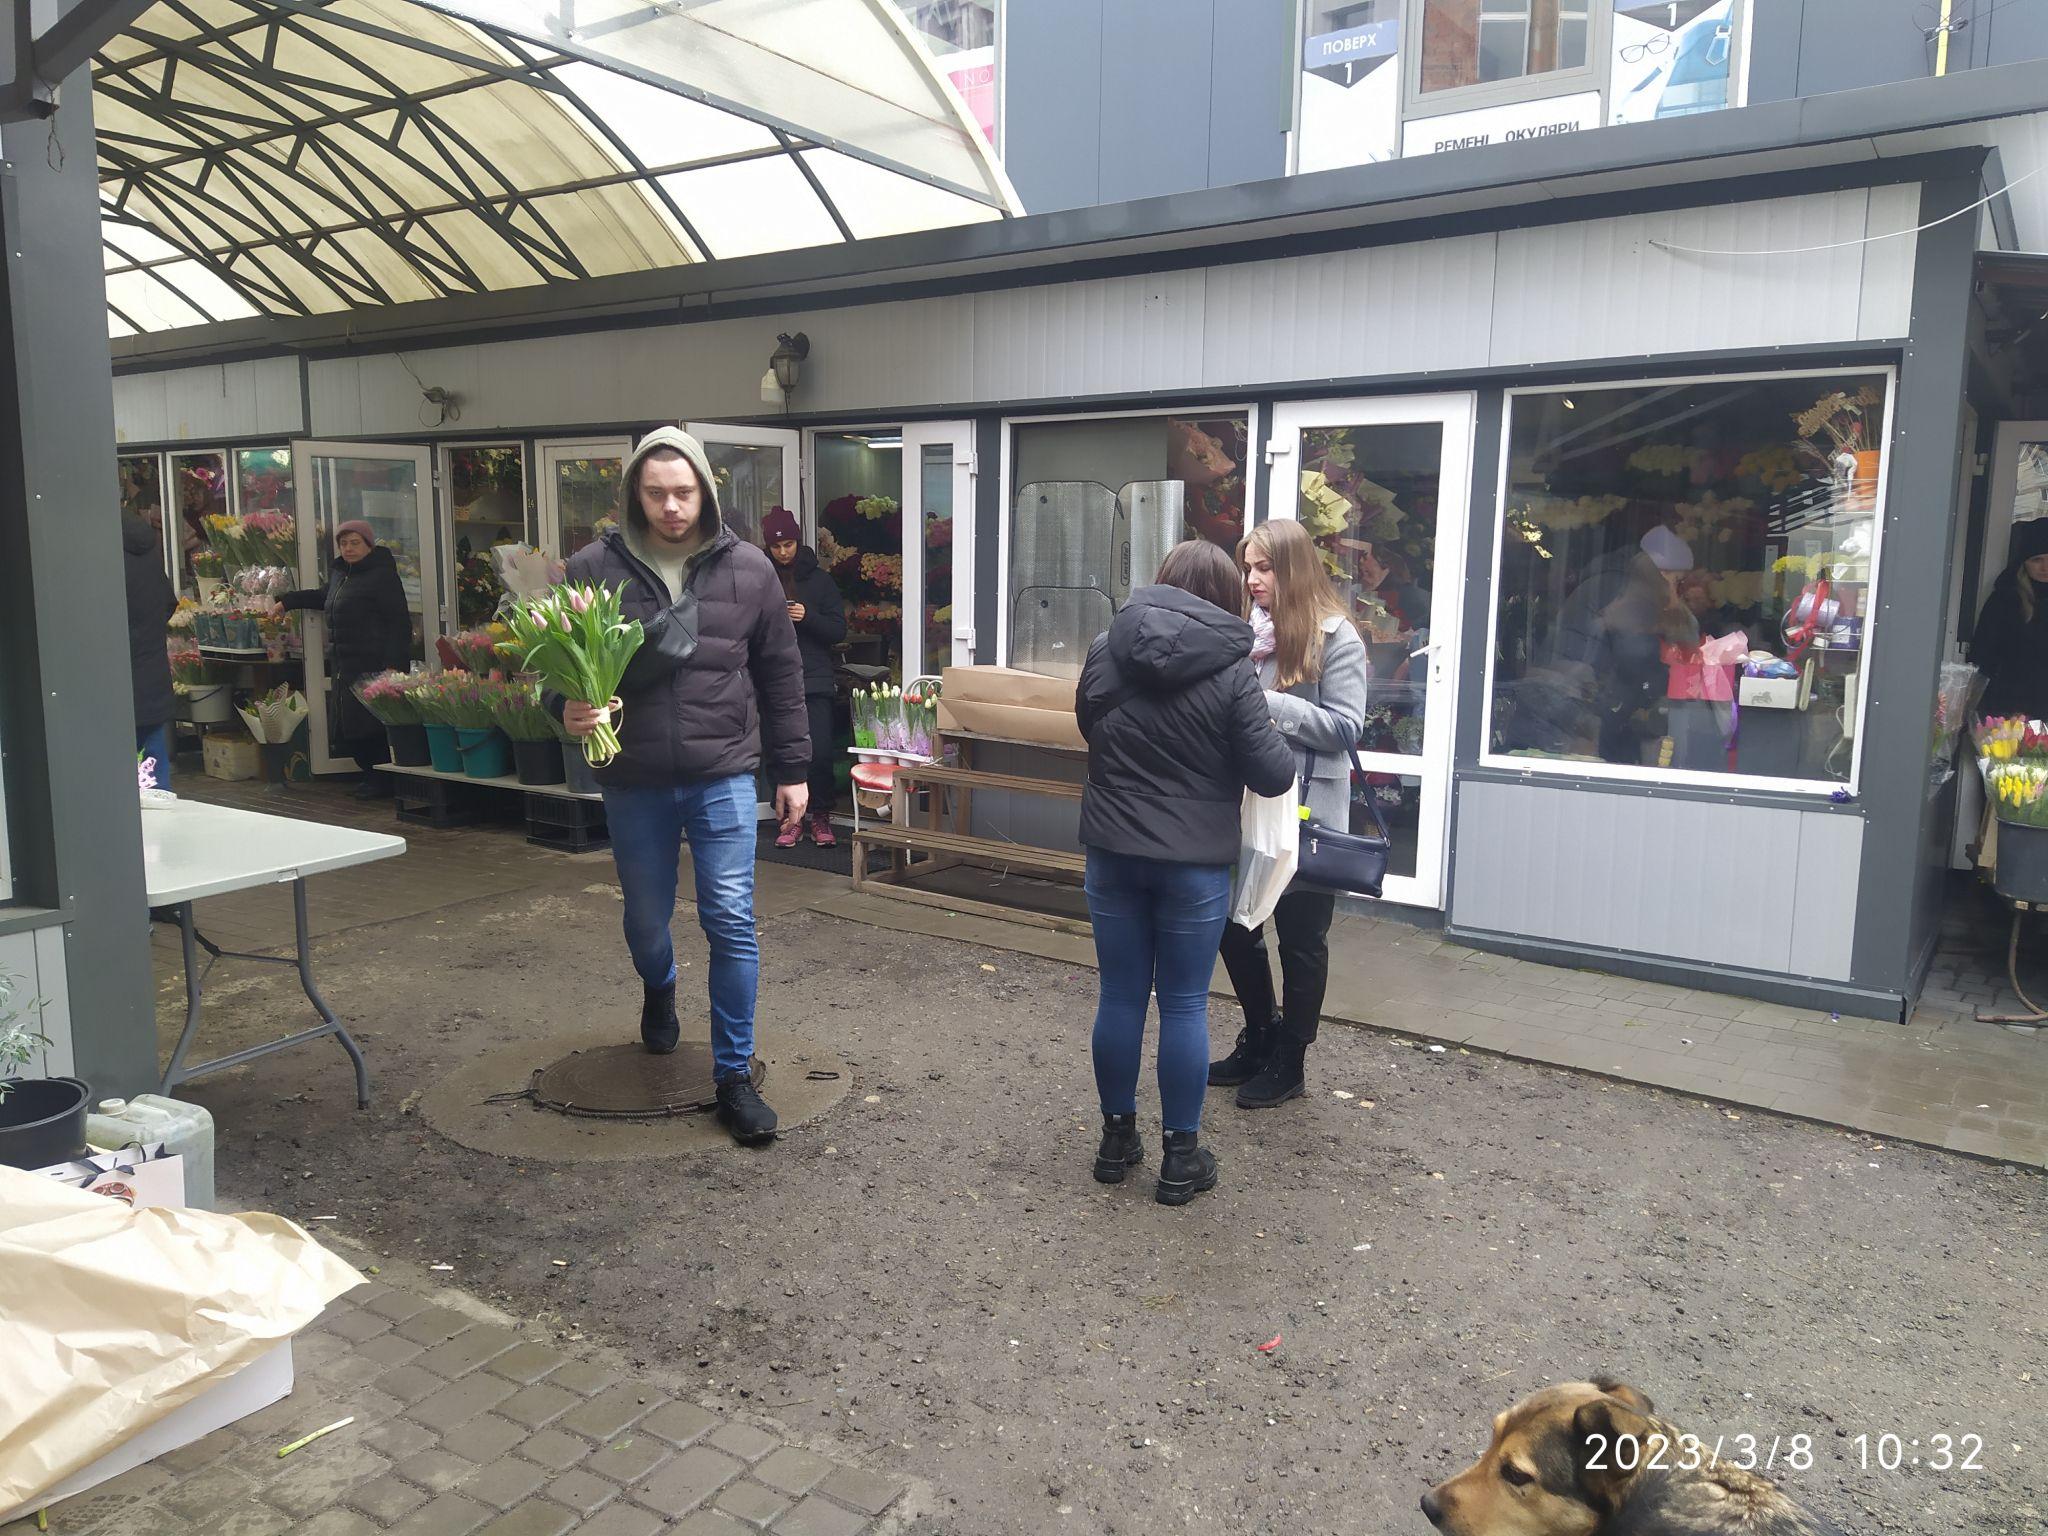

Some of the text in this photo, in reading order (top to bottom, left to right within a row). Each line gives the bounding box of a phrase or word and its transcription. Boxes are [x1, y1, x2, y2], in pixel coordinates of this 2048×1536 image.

[1666, 2, 1677, 26] 1
[1323, 33, 1376, 55] ПОВЕРХ
[1345, 62, 1352, 84] 1
[1505, 121, 1579, 142] ОКУЛЯРИ
